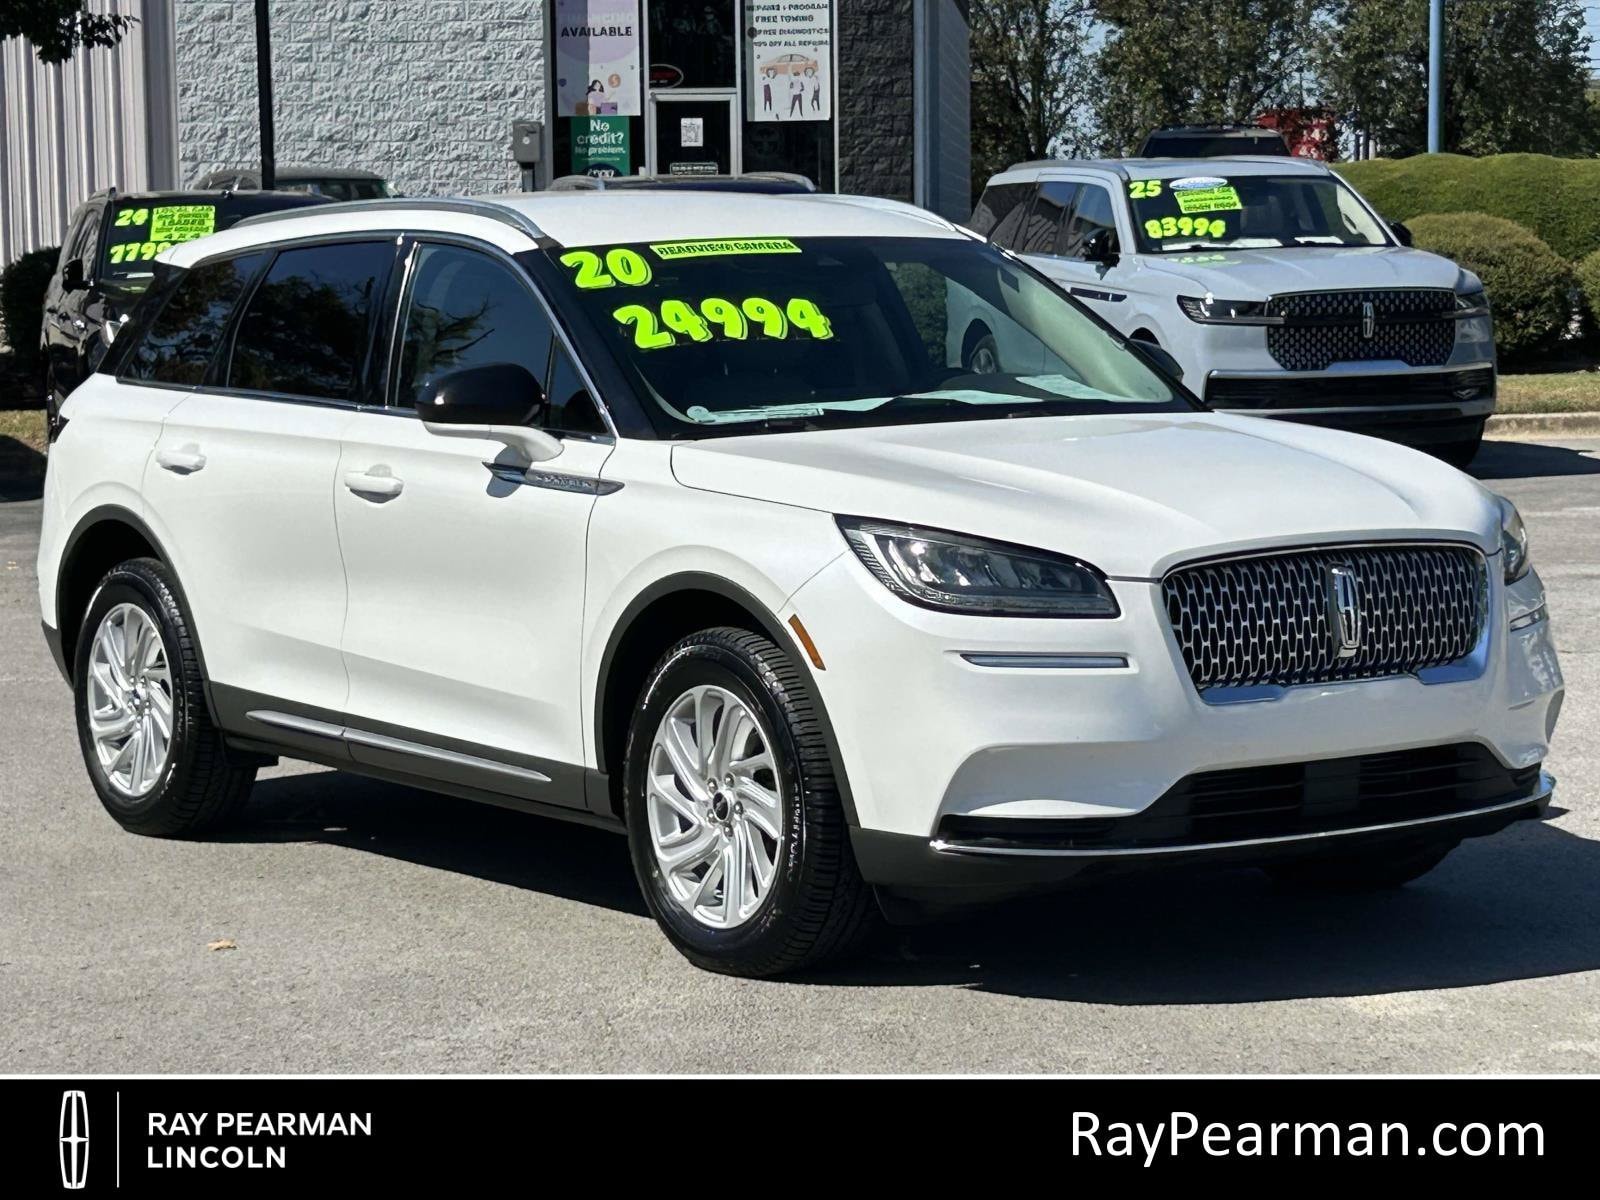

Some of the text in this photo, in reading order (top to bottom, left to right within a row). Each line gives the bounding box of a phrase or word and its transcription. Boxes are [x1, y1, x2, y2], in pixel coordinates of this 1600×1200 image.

[755, 15, 778, 23] FREE
[561, 26, 632, 37] AVAILABLE
[589, 119, 610, 132] No
[576, 132, 624, 145] credit?
[1129, 180, 1162, 199] 25
[115, 208, 149, 226] 24
[1145, 216, 1226, 239] 83994
[734, 241, 796, 251] CAMERA
[560, 249, 653, 289] 20
[613, 297, 834, 349] 24994
